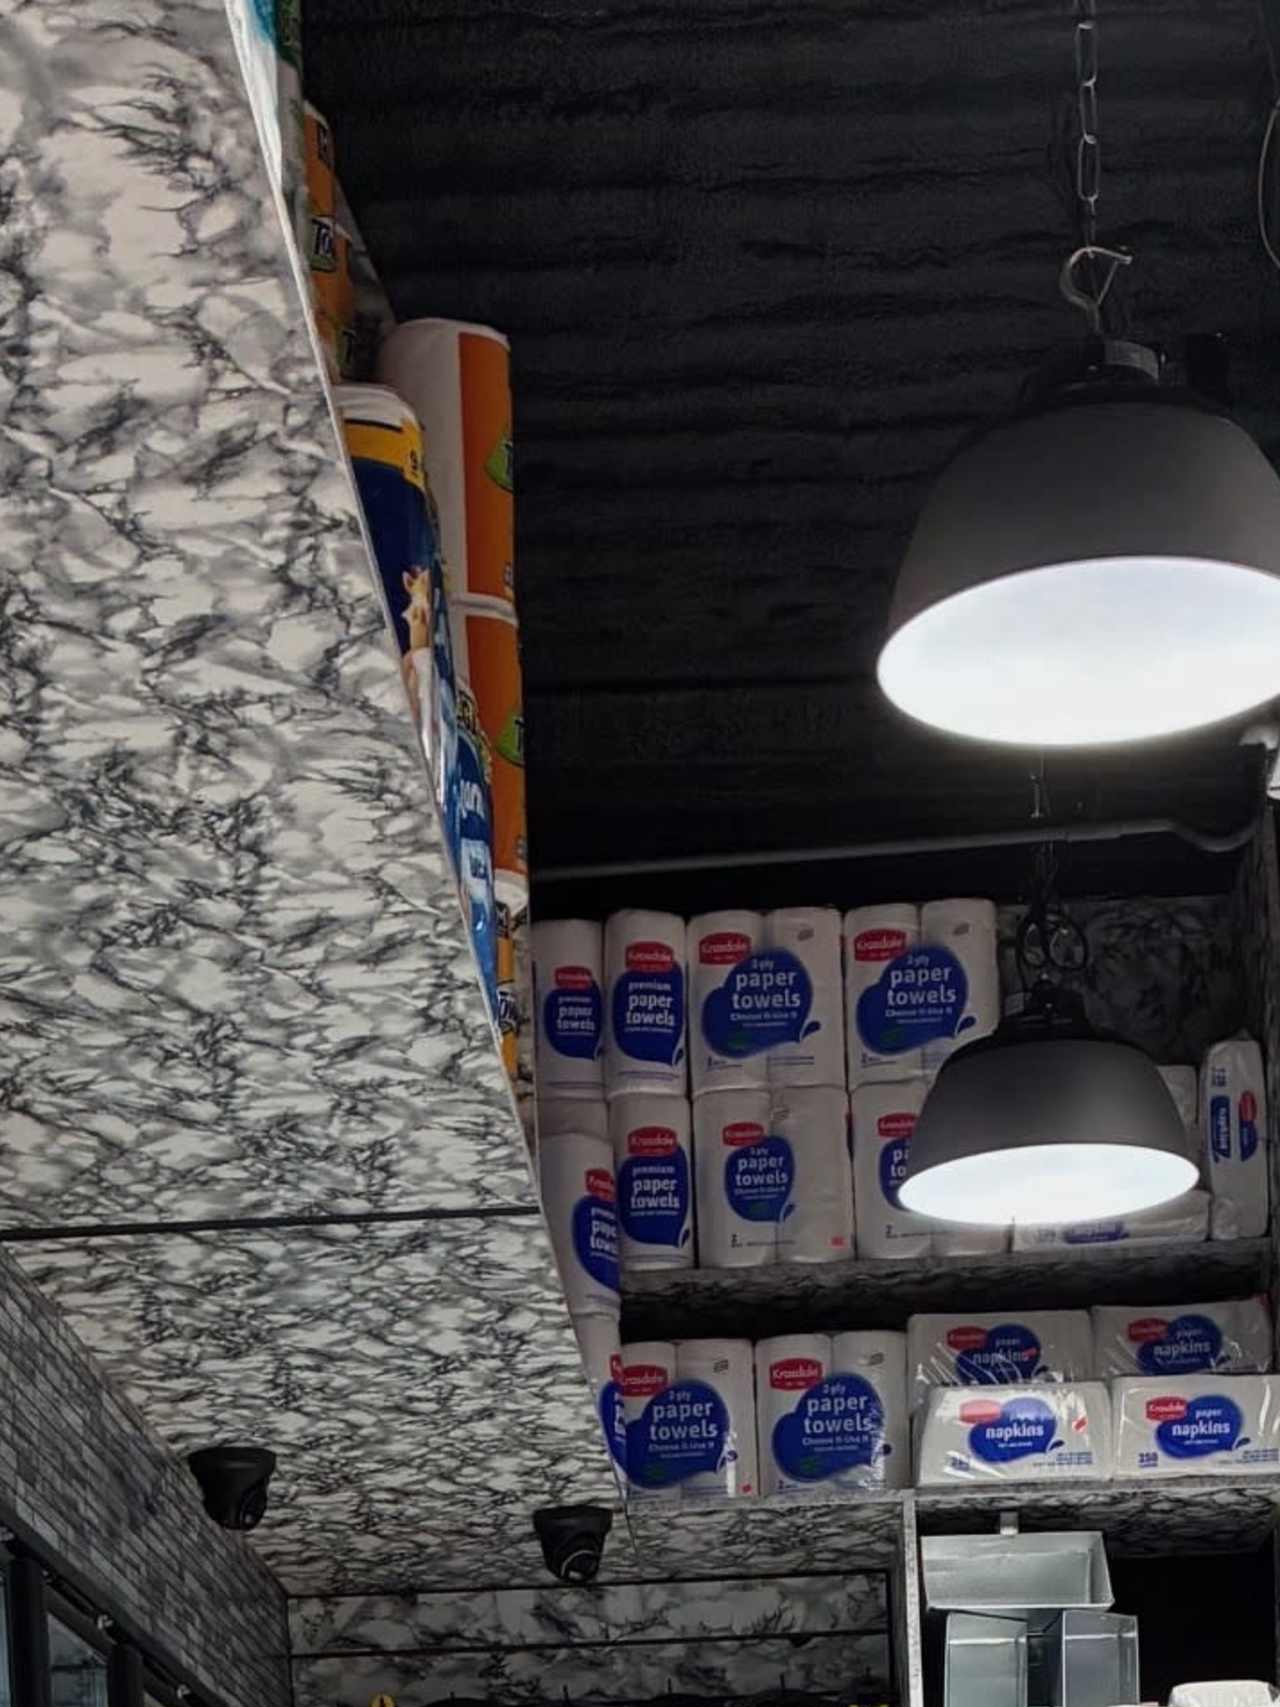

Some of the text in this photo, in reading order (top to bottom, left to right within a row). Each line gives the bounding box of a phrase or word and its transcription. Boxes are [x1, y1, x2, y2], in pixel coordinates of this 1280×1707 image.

[735, 971, 797, 992] paper
[891, 967, 952, 988] paper
[628, 994, 673, 1009] paper
[732, 990, 801, 1010] towels
[887, 984, 957, 1006] towels
[626, 1010, 674, 1026] towels
[738, 1157, 784, 1173] paper
[735, 1172, 789, 1187] towels
[632, 1180, 678, 1197] paper
[630, 1195, 681, 1209] towels
[1154, 1341, 1211, 1357] napkins
[652, 1402, 714, 1423] paper
[807, 1395, 869, 1417] paper
[649, 1420, 718, 1442] towels
[804, 1414, 872, 1436] towels
[985, 1425, 1045, 1440] napkins
[1172, 1421, 1231, 1437] napkins
